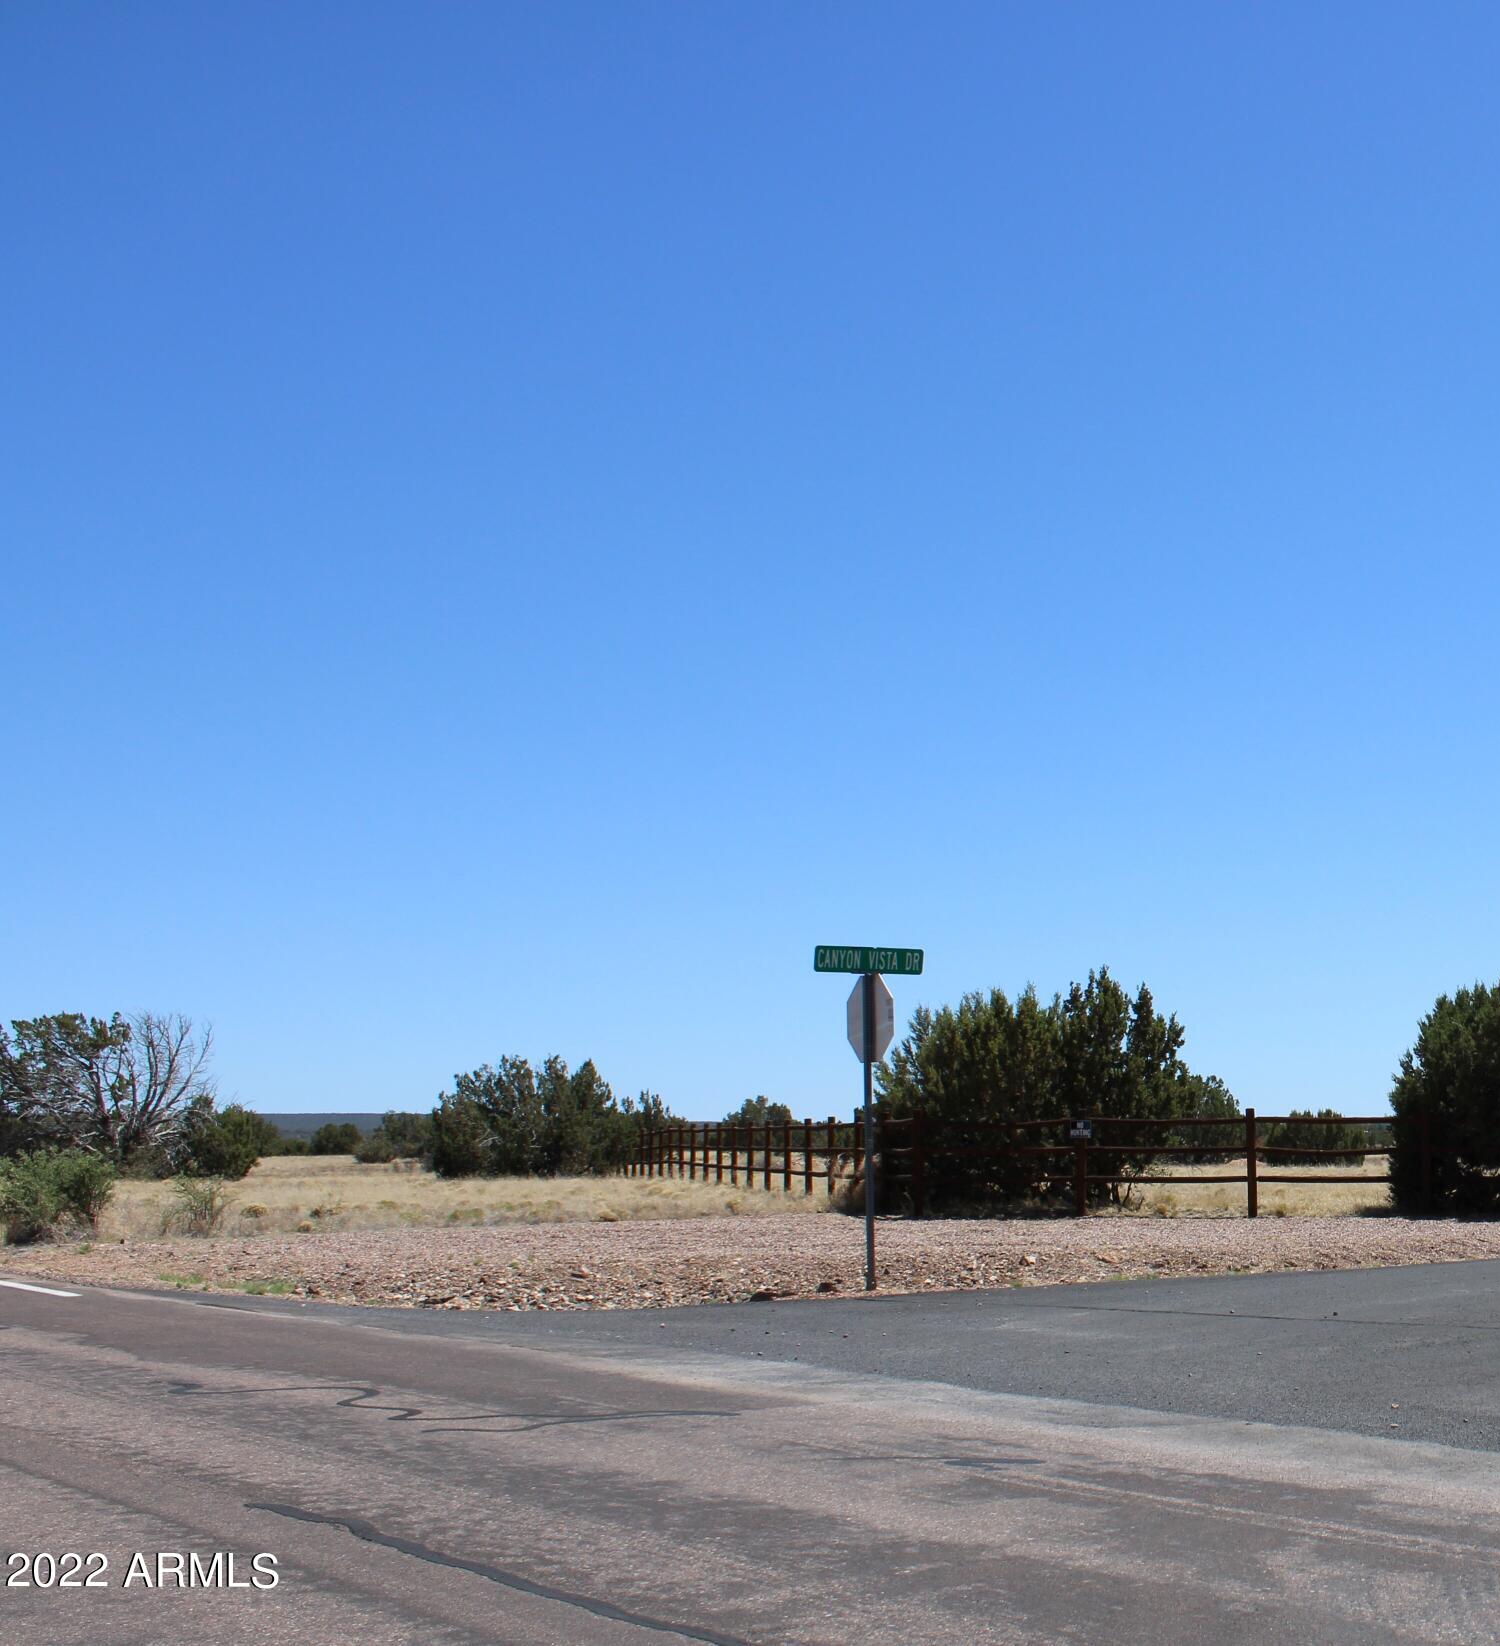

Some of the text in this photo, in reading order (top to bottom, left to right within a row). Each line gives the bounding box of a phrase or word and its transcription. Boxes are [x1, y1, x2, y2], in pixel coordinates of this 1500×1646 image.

[817, 949, 920, 971] CANYON VISTA DR
